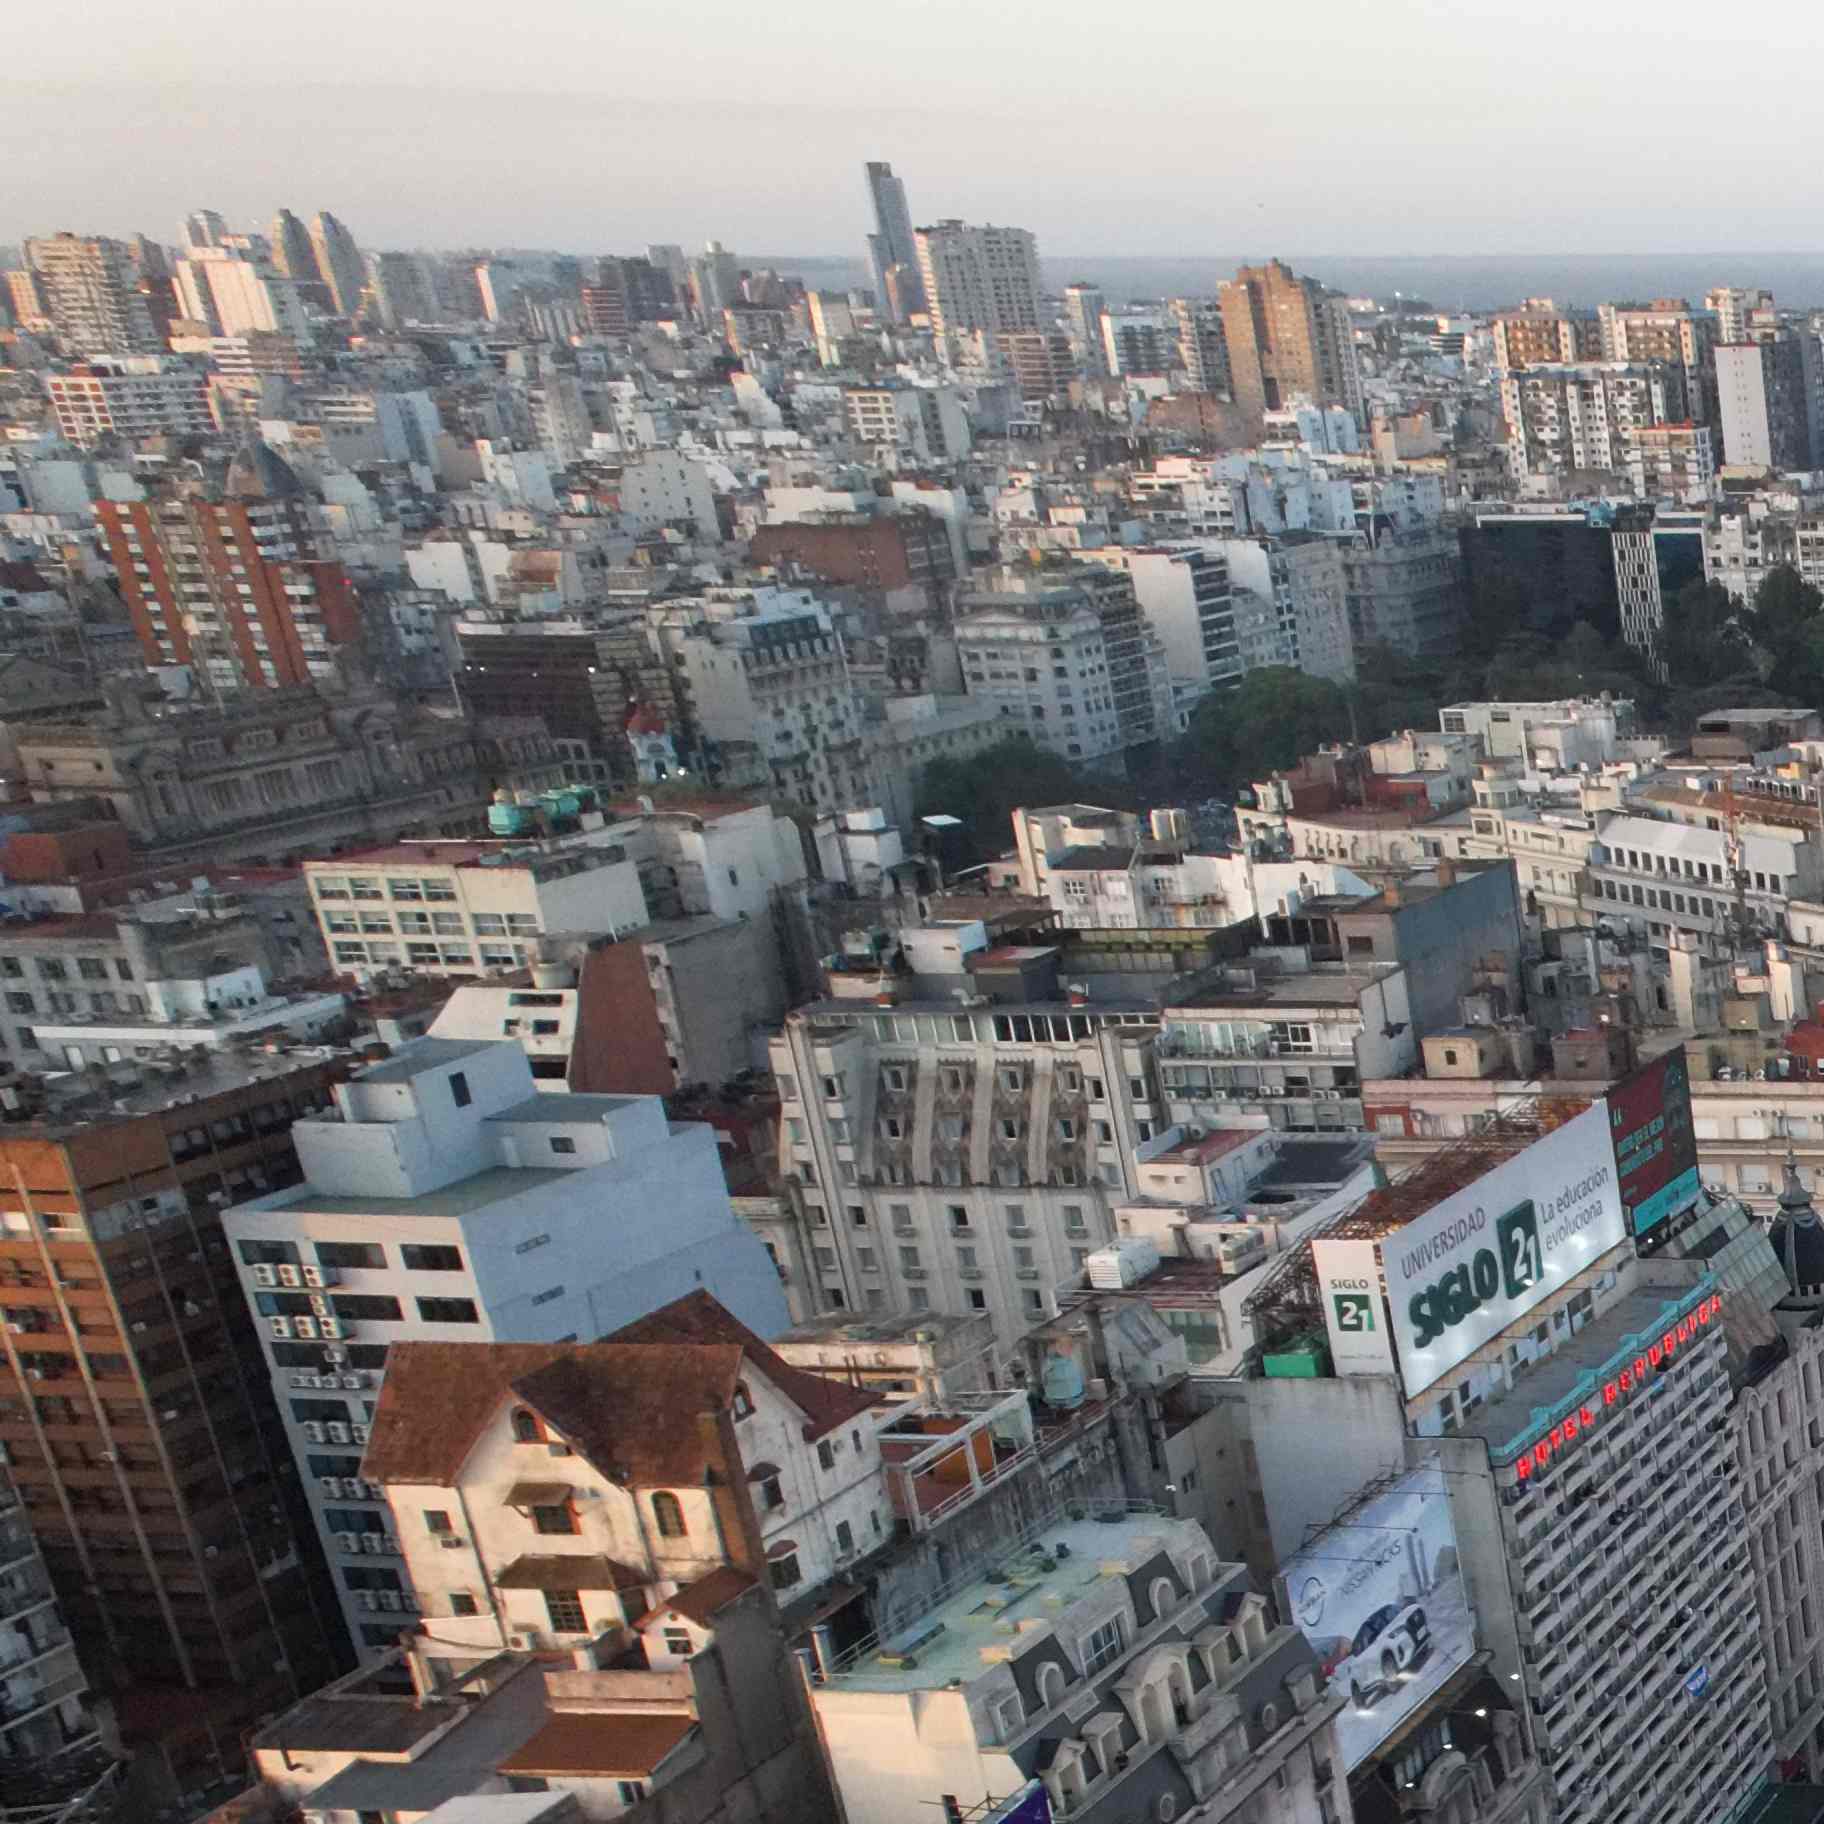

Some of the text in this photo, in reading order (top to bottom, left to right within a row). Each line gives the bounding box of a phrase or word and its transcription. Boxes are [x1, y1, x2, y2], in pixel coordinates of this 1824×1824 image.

[1540, 1203, 1556, 1224] La
[1545, 1199, 1604, 1250] evoluciona
[1401, 1207, 1487, 1280] UNIVERSIDAD
[1330, 1279, 1369, 1290] SIGLO
[1409, 1248, 1499, 1349] SIGLO
[1341, 1301, 1370, 1331] 21
[1516, 1407, 1595, 1479] HOTEL
